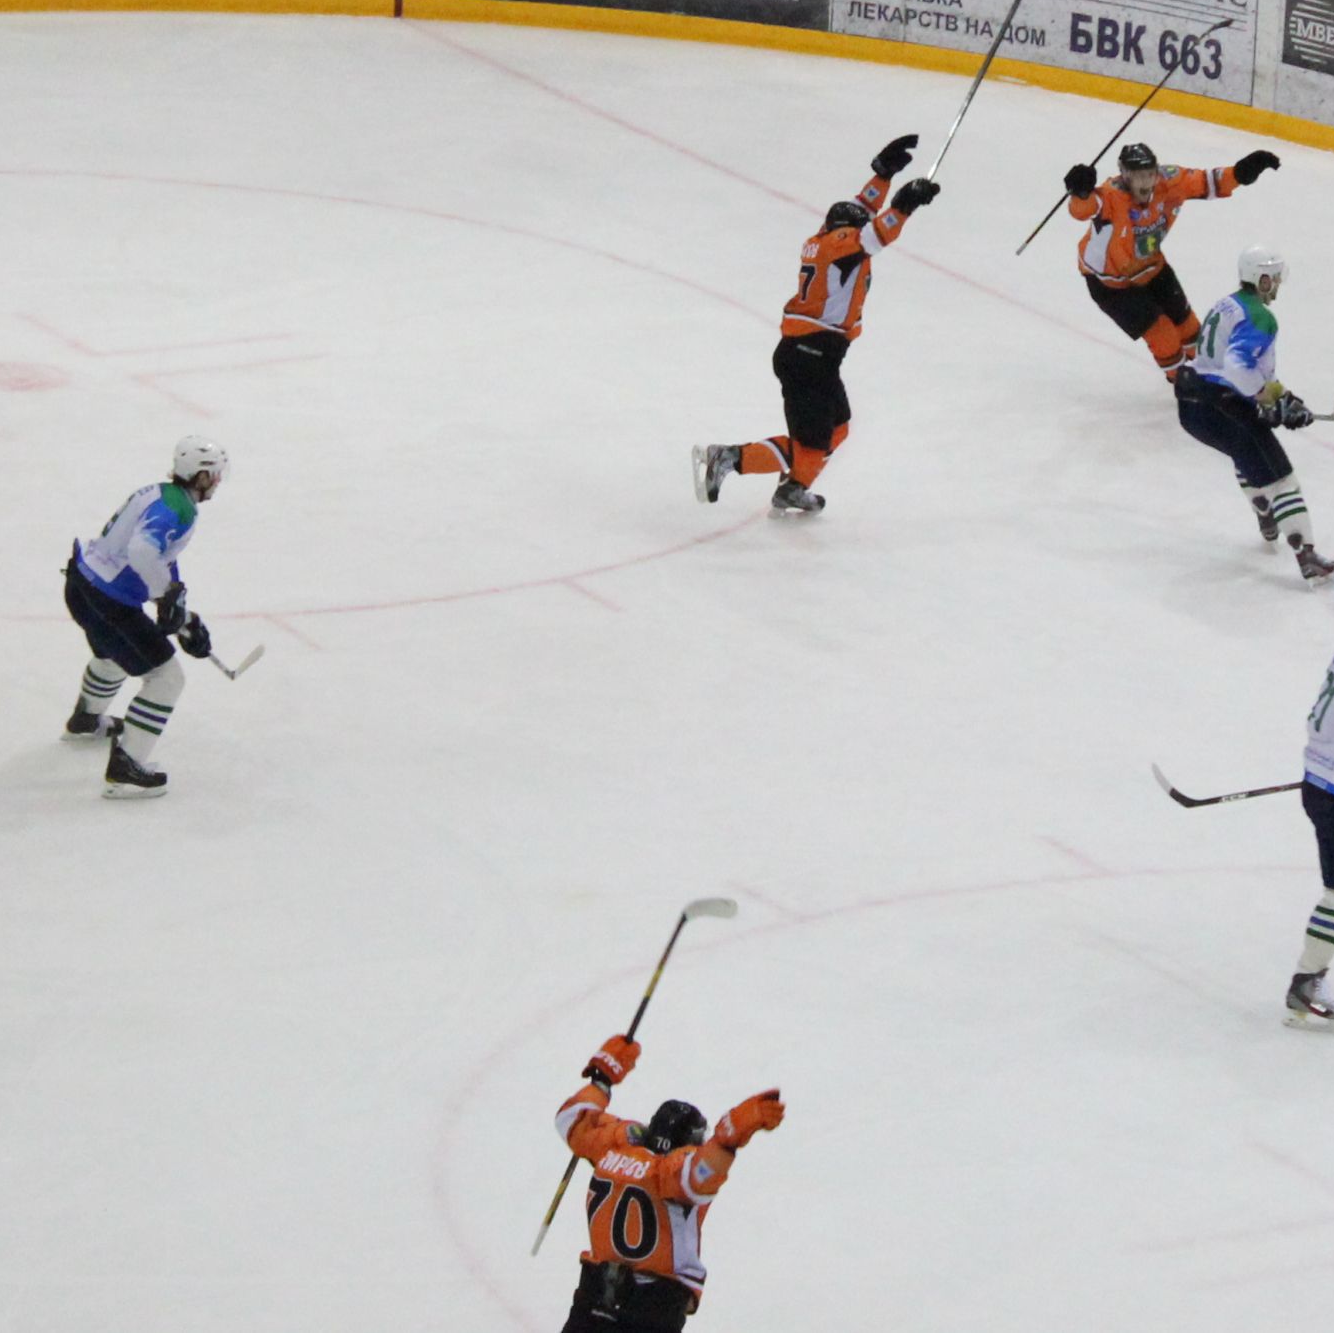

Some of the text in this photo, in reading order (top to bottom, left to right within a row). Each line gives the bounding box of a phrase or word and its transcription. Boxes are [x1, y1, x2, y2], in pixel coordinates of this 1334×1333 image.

[849, 1, 1046, 47] ЛЕКАРСТВ НА ДОМ
[1069, 13, 1224, 81] БВК 663
[656, 1136, 671, 1151] 70
[587, 1175, 659, 1262] 70
